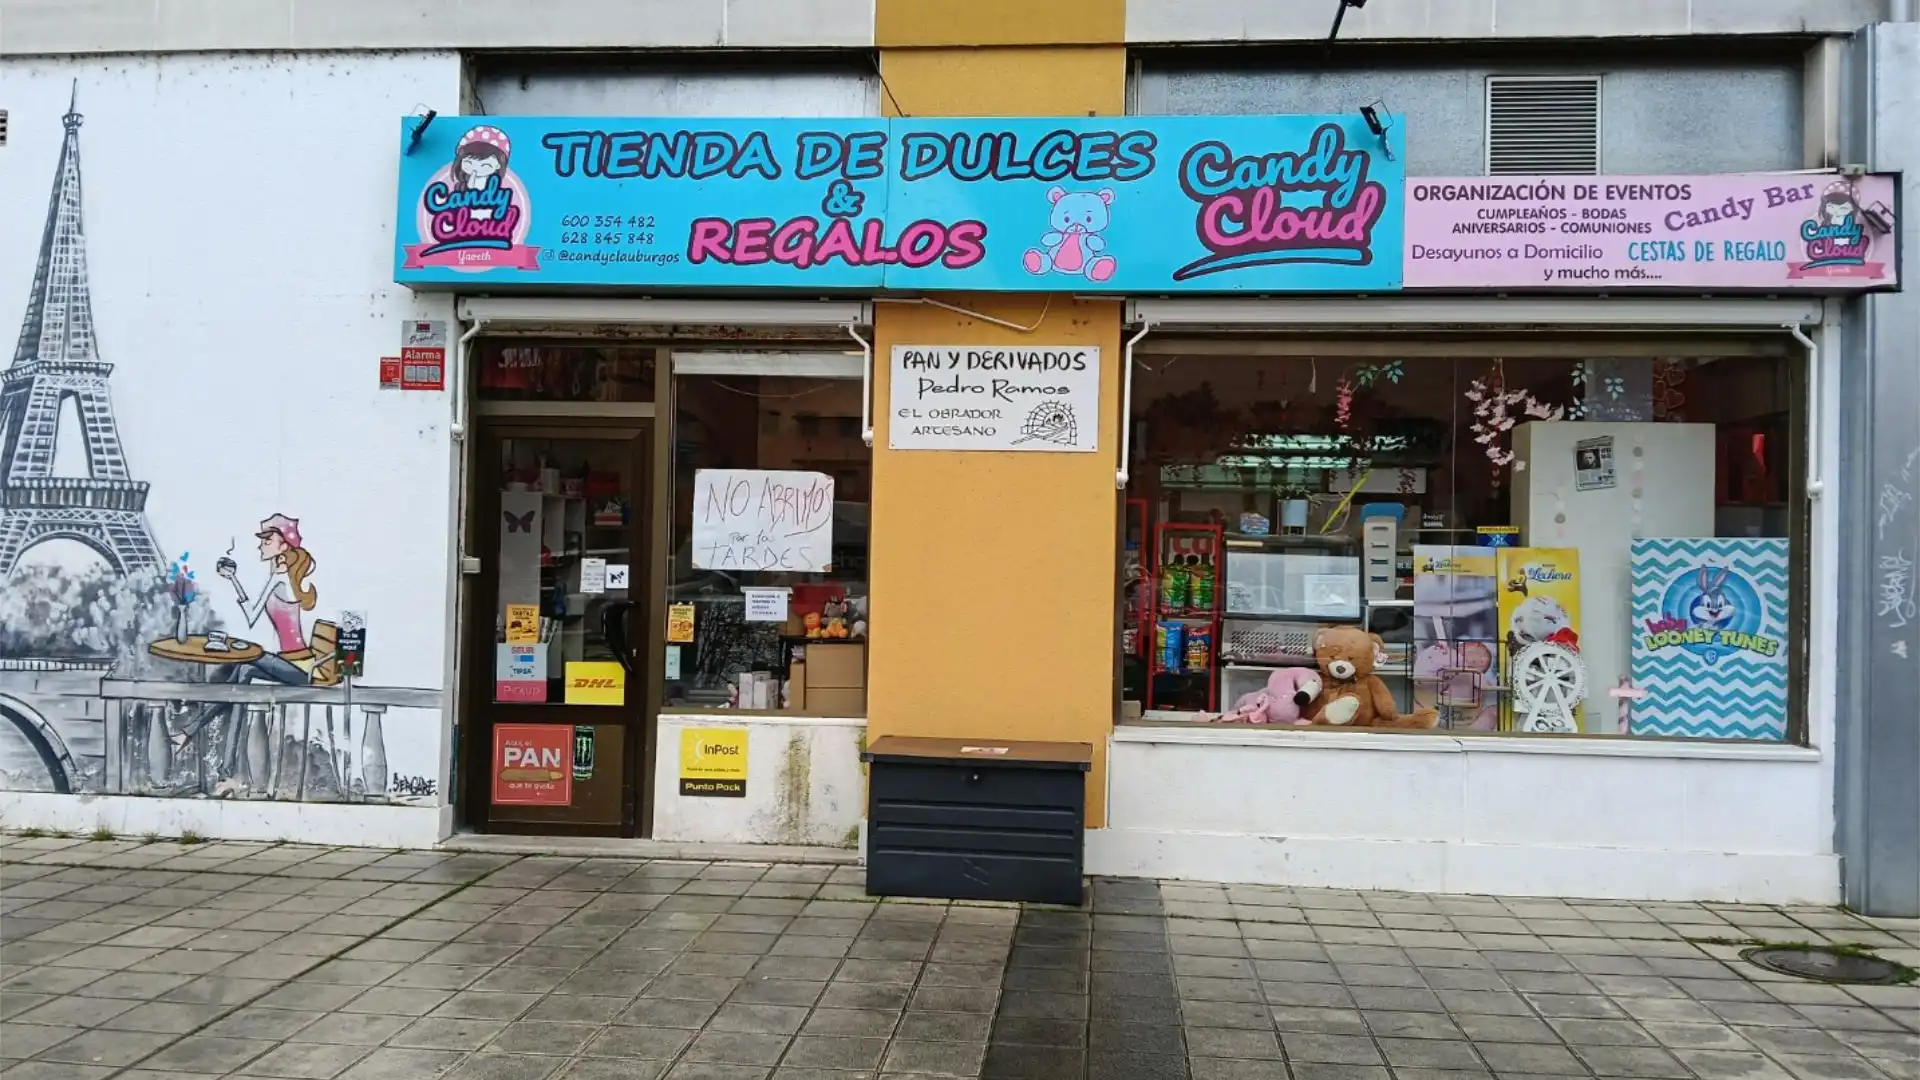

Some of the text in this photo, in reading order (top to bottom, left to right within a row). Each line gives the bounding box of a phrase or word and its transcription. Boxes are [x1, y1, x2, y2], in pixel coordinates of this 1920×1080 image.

[542, 129, 1157, 181] TIENDA DE DULCES
[1178, 123, 1371, 210] Candy
[424, 174, 513, 221] Candy
[822, 180, 865, 217] &
[1413, 179, 1692, 201] ORGANIZACIÓN DE EVENTOS
[1199, 180, 1387, 253] Cloud
[1477, 205, 1567, 220] CUMPLEAÑOS
[1582, 208, 1627, 220] BODAS
[1664, 183, 1814, 231] Candy Bar
[431, 205, 520, 241] Cloud
[562, 215, 655, 228] 600 354 482
[1452, 222, 1546, 234] ANIVERSARIOS
[1560, 222, 1652, 234] COMUNIONES
[1800, 215, 1864, 246] Candy
[561, 232, 654, 244] 628 845 848
[687, 215, 987, 269] REGALOS
[1806, 235, 1869, 260] Cloud
[559, 249, 680, 267] @candyclauburgos
[1412, 244, 1603, 262] Desayunos a Domicilio
[1628, 240, 1786, 262] CESTAS DE REGALO
[1544, 269, 1553, 281] y
[1557, 265, 1609, 279] mucho
[404, 349, 441, 359] Alarma
[903, 350, 1087, 373] PAN Y DERIVADOS
[918, 374, 1071, 403] Pedro Ramos
[898, 408, 1003, 420] EL OBRADOR
[911, 425, 997, 437] ARTESANO
[705, 475, 751, 523] NO
[700, 540, 814, 571] TARDES
[1644, 627, 1714, 651] LOONEY
[1720, 629, 1779, 657] TUNES
[573, 678, 617, 688] DHL
[504, 747, 561, 768] PAN
[704, 744, 740, 755] InPost
[716, 783, 741, 791] Pack
